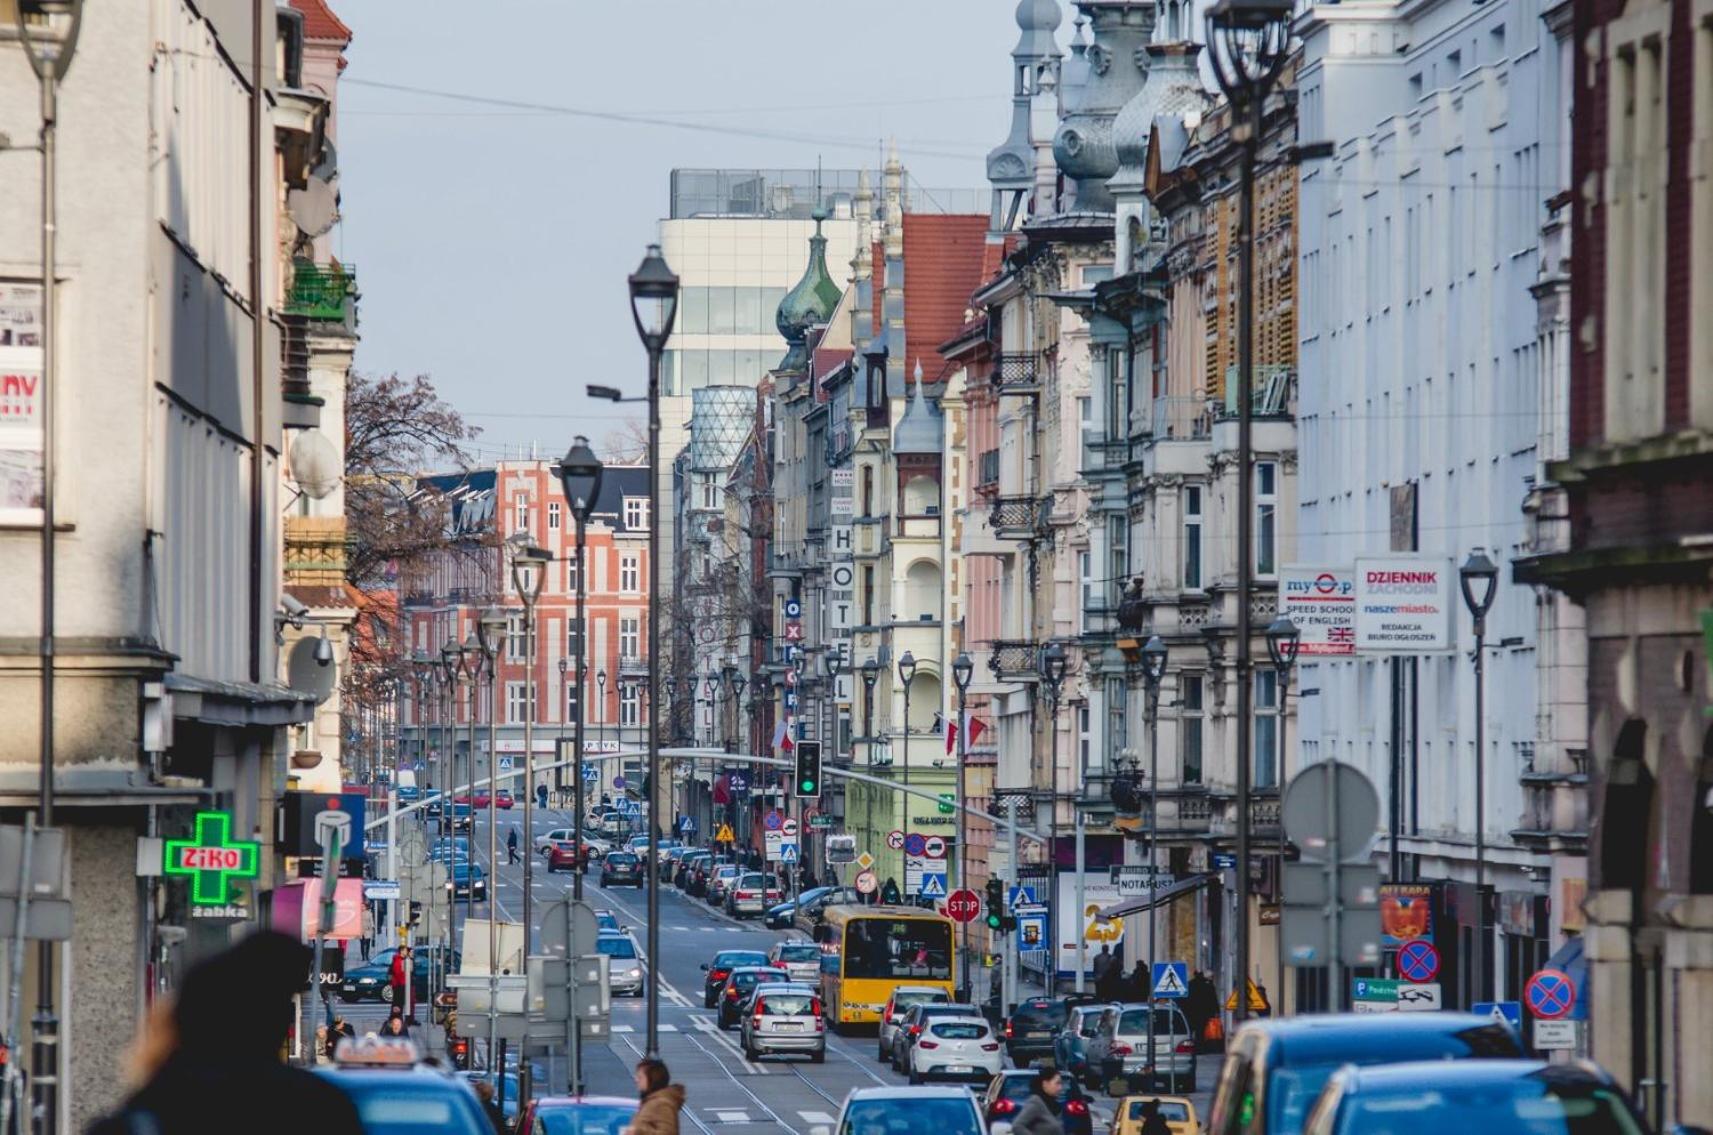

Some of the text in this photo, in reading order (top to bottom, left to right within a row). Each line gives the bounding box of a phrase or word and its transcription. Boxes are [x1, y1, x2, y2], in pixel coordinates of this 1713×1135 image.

[1367, 572, 1437, 583] DZIENNIK
[1367, 584, 1438, 595] ZACHODNI
[833, 529, 853, 698] HOTEL
[1287, 605, 1354, 614] SPEED SCHOO
[1293, 616, 1351, 625] OF ENGLISH
[1121, 880, 1174, 890] NOTARUSZ
[950, 900, 978, 912] STOP
